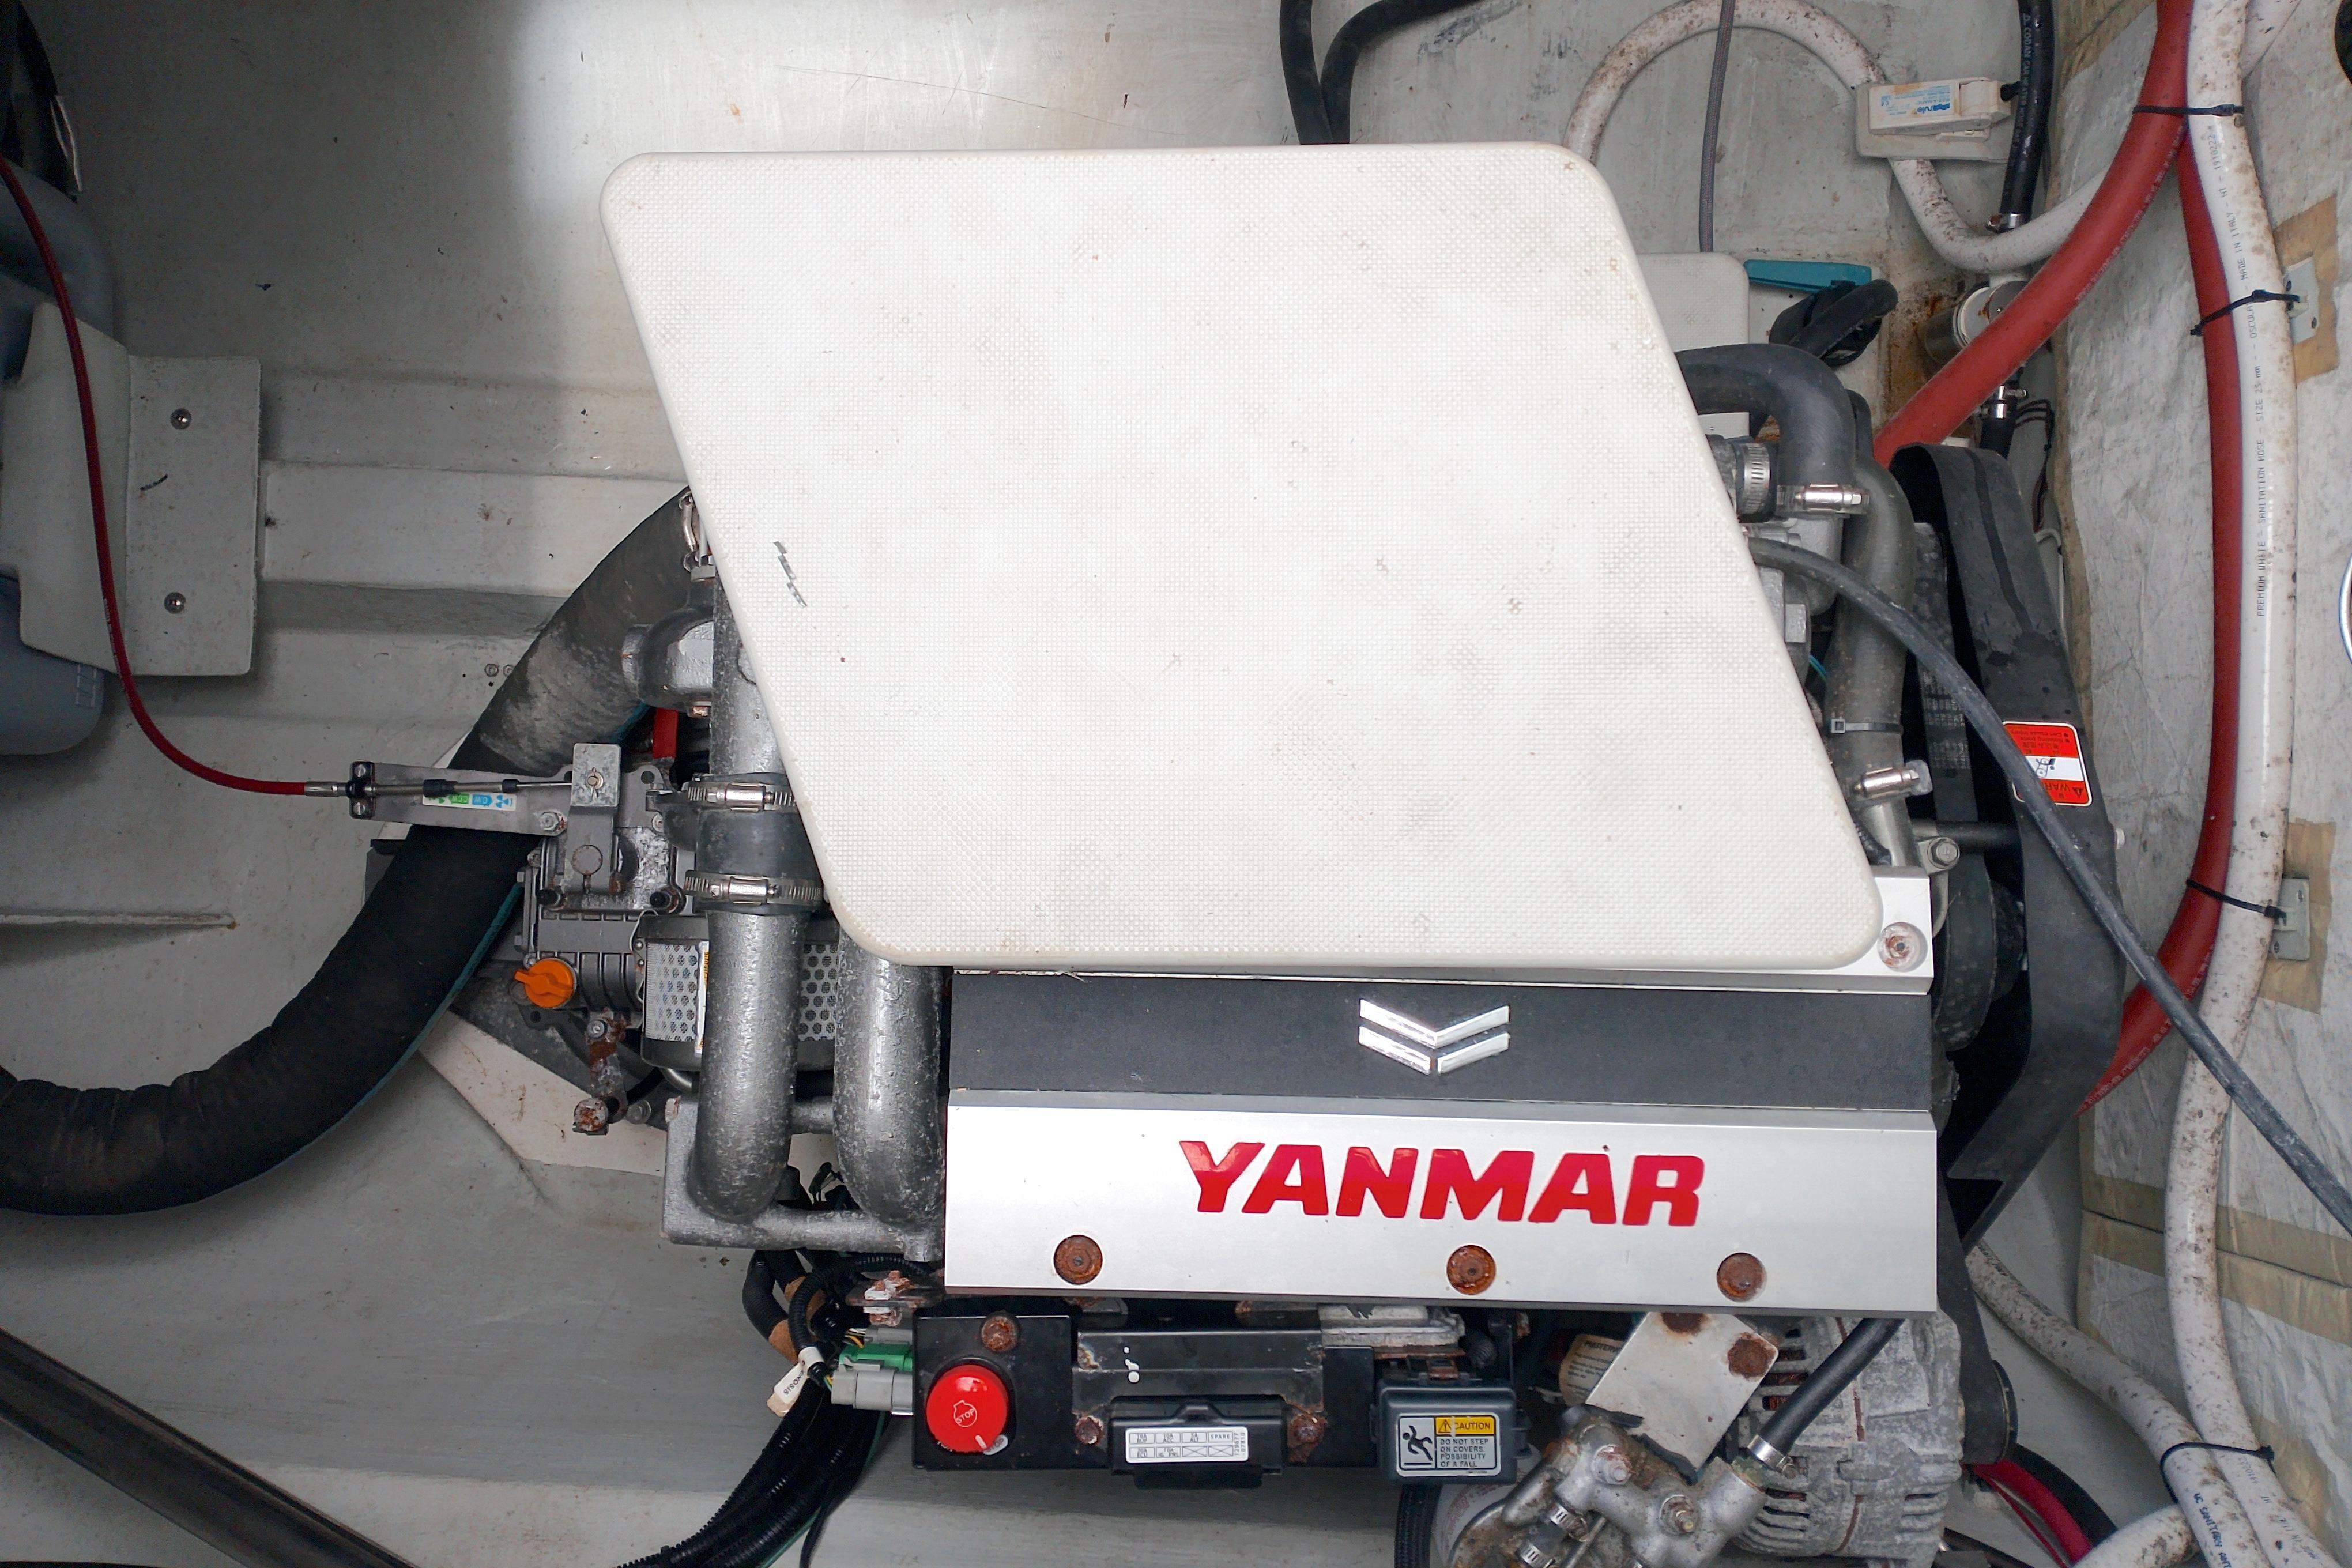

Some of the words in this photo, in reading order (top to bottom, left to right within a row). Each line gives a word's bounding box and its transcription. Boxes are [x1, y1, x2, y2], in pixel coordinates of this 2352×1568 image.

[2226, 212, 2240, 238] ITALY
[2234, 242, 2243, 254] IN
[2237, 258, 2248, 280] MADE
[2247, 301, 2257, 339] OSCULA
[2255, 366, 2261, 378] mm
[2255, 383, 2263, 394] 25
[2256, 399, 2264, 422] SIZE
[2257, 439, 2265, 461] HOSE
[2257, 467, 2266, 524] SANITATION
[2257, 541, 2266, 570] WHITE
[2257, 576, 2266, 617] PREMIUM
[1179, 1140, 1705, 1227] YANMAR
[956, 1408, 975, 1424] STOP
